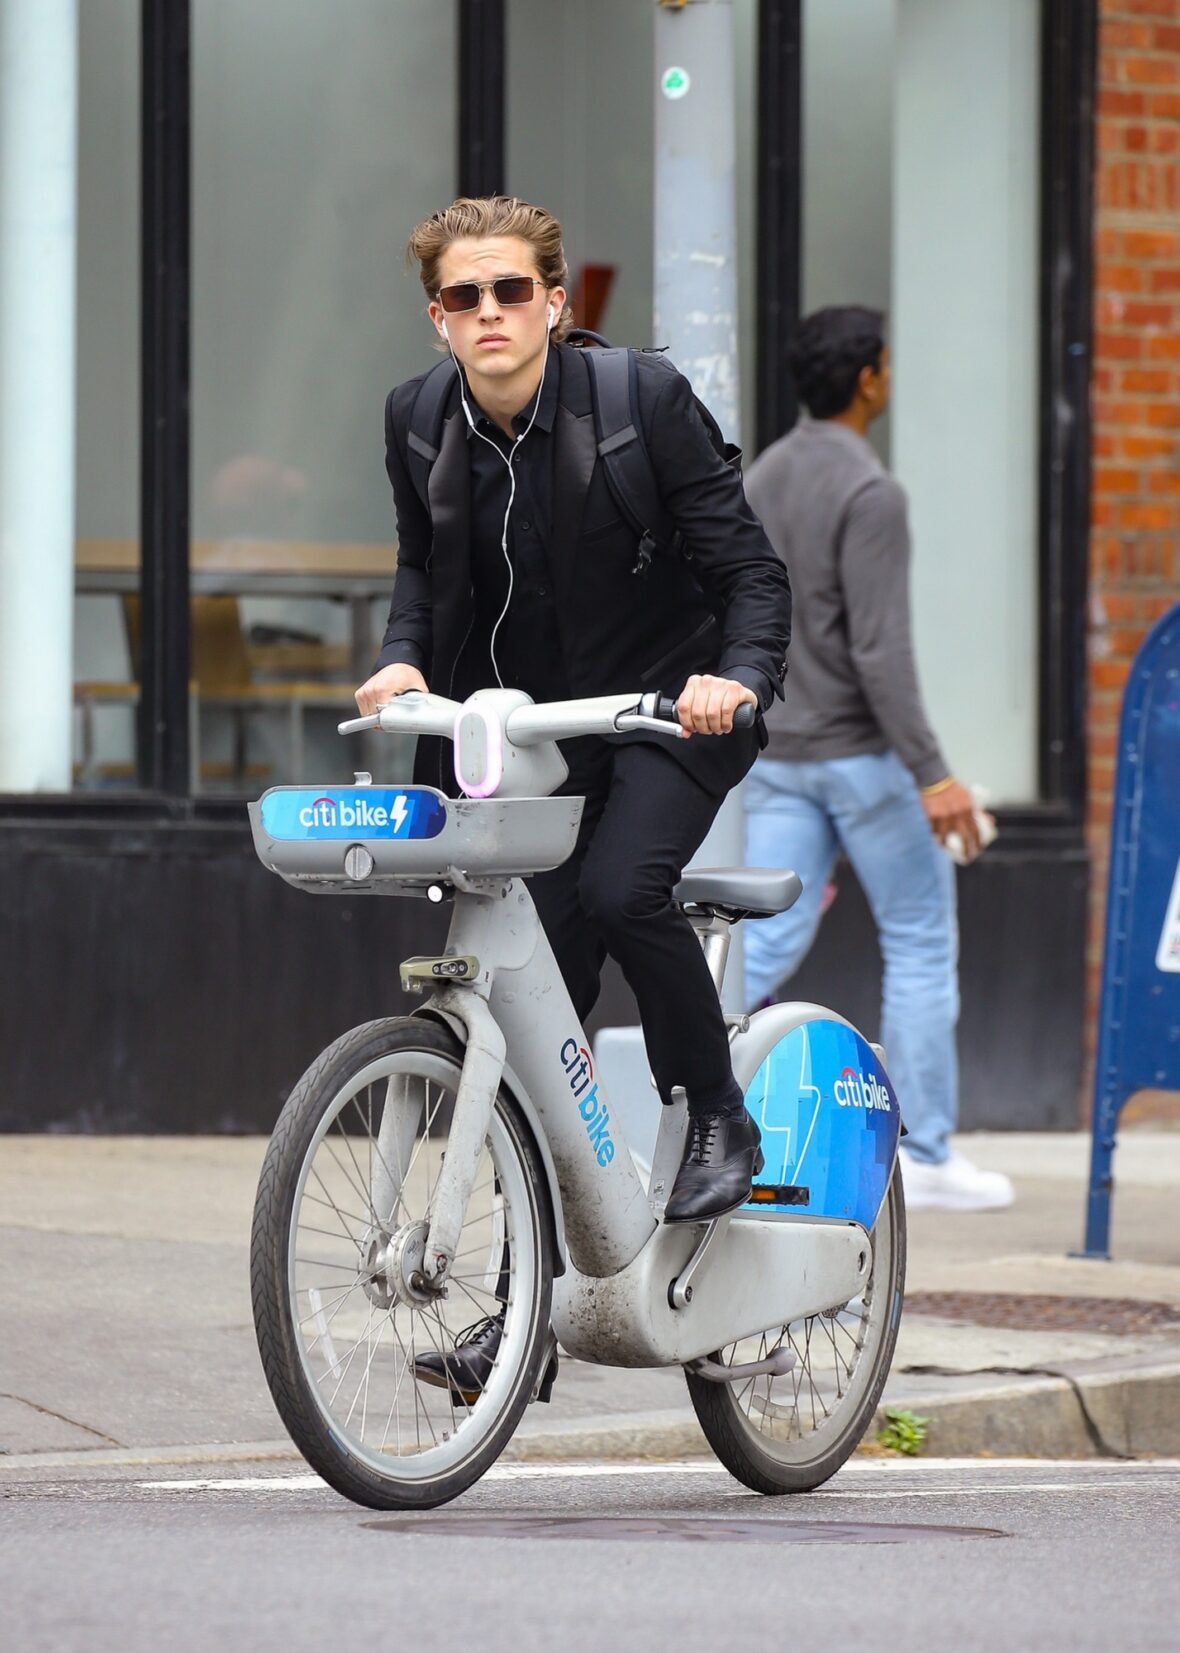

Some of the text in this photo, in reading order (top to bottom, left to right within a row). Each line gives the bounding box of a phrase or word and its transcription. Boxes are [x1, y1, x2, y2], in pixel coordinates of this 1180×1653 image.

[299, 798, 388, 827] citi bike
[560, 1038, 615, 1168] citi bike
[834, 1067, 891, 1112] citi bike
